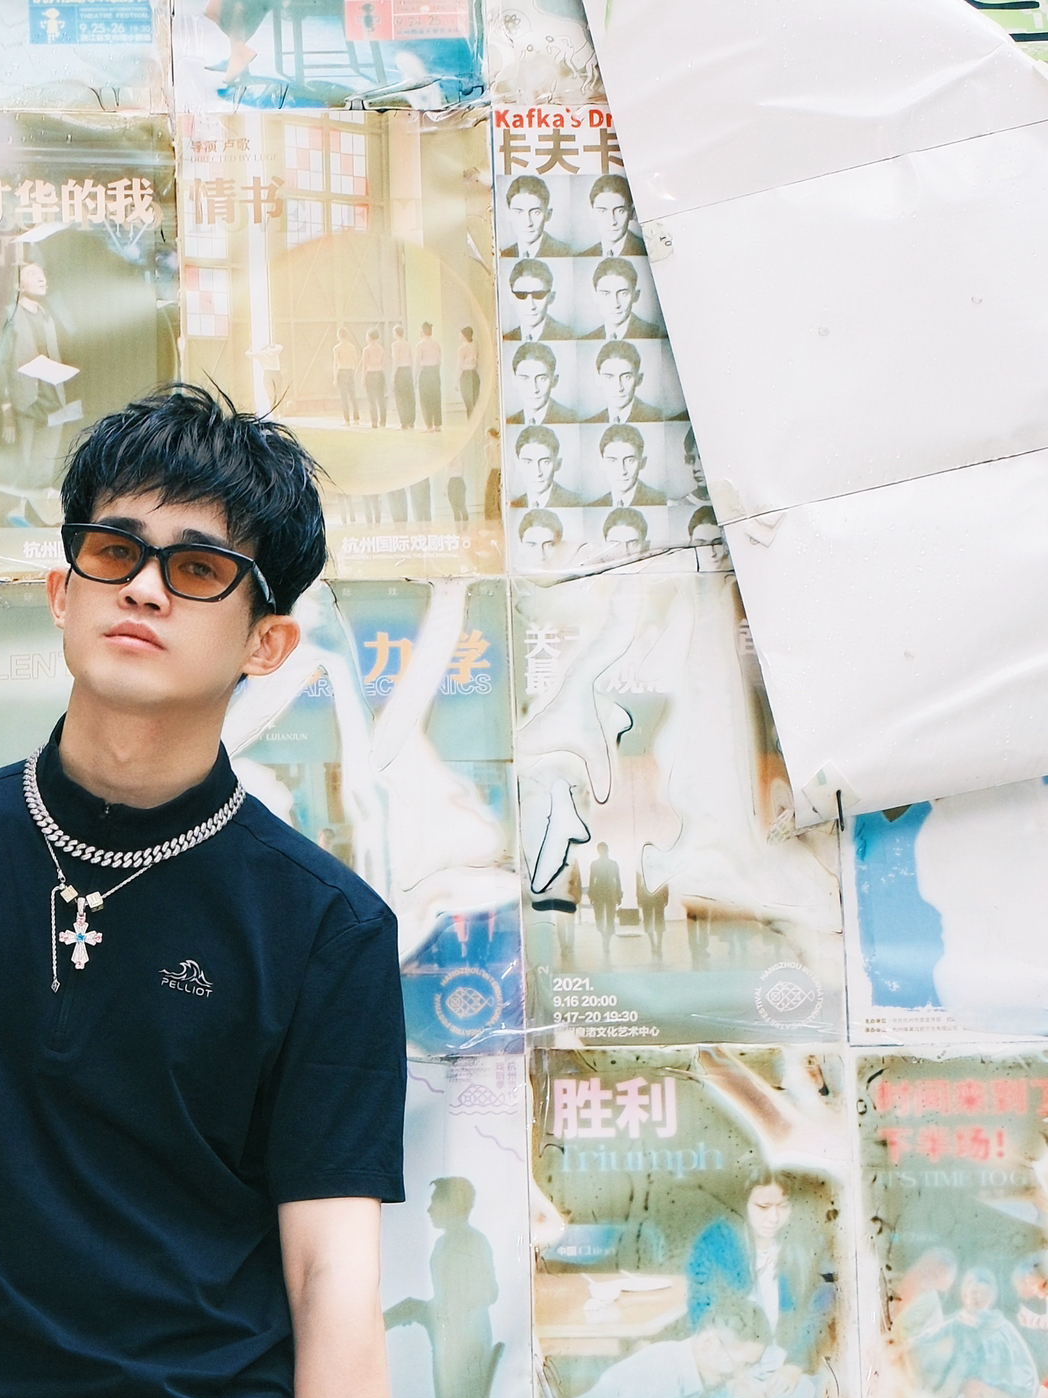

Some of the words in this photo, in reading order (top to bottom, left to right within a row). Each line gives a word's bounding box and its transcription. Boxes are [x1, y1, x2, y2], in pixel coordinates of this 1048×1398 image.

[191, 139, 217, 153] 导演
[223, 138, 250, 152] 卢歌
[189, 175, 286, 225] 情书
[342, 534, 460, 553] 杭州国际戏剧节
[161, 977, 213, 997] PELLIOT
[553, 978, 594, 991] 2021.
[553, 996, 579, 1007] 9.16
[581, 995, 617, 1006] 20:00
[553, 1012, 601, 1023] 9.17-20
[604, 1011, 638, 1022] 19:30
[553, 1076, 678, 1139] 胜利
